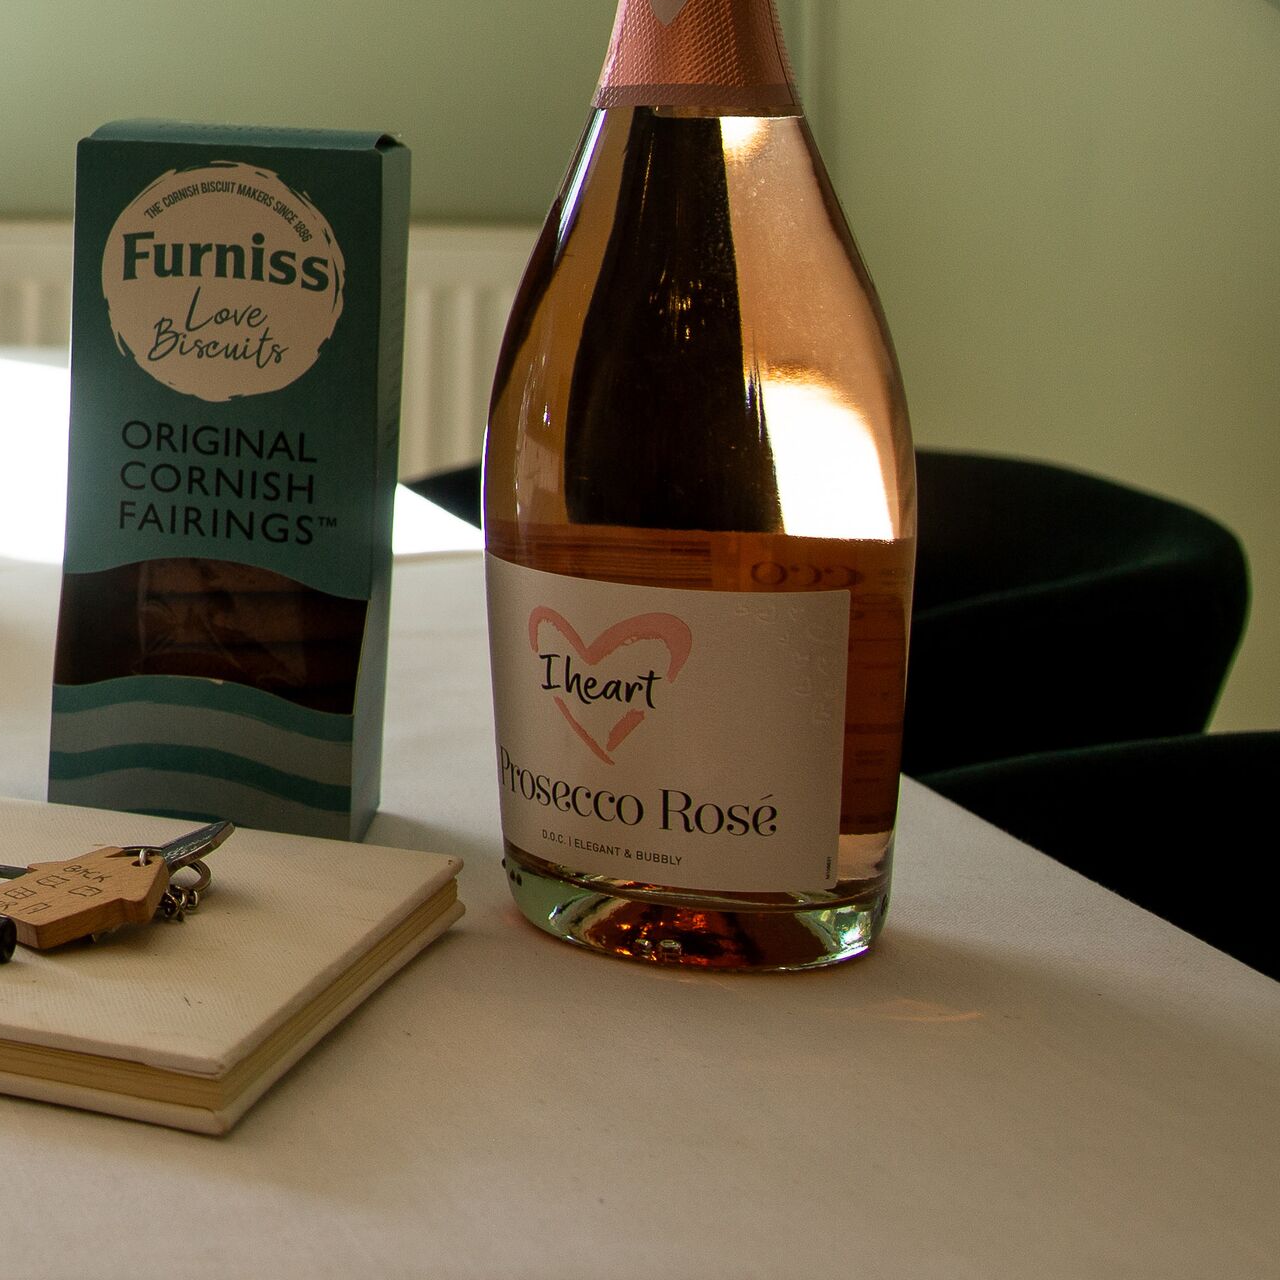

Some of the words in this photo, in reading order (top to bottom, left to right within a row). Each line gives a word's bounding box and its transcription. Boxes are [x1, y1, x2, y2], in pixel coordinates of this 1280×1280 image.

[144, 201, 164, 219] THE
[162, 183, 200, 209] CORNISH
[201, 180, 236, 194] BISCUIT
[237, 183, 274, 208] MAKERS
[272, 200, 299, 225] SINCE
[293, 220, 313, 244] 1886
[122, 230, 330, 292] Furniss
[184, 286, 268, 332] Love
[146, 317, 290, 369] Biscuits
[121, 420, 318, 464] ORIGINAL
[120, 461, 314, 504] CORNISH
[499, 744, 645, 826] Prosecco
[659, 787, 778, 837] Rosé
[62, 863, 113, 883] BACK
[574, 838, 621, 857] ELEGANT
[624, 848, 632, 859] &
[636, 850, 683, 867] BUBBLY
